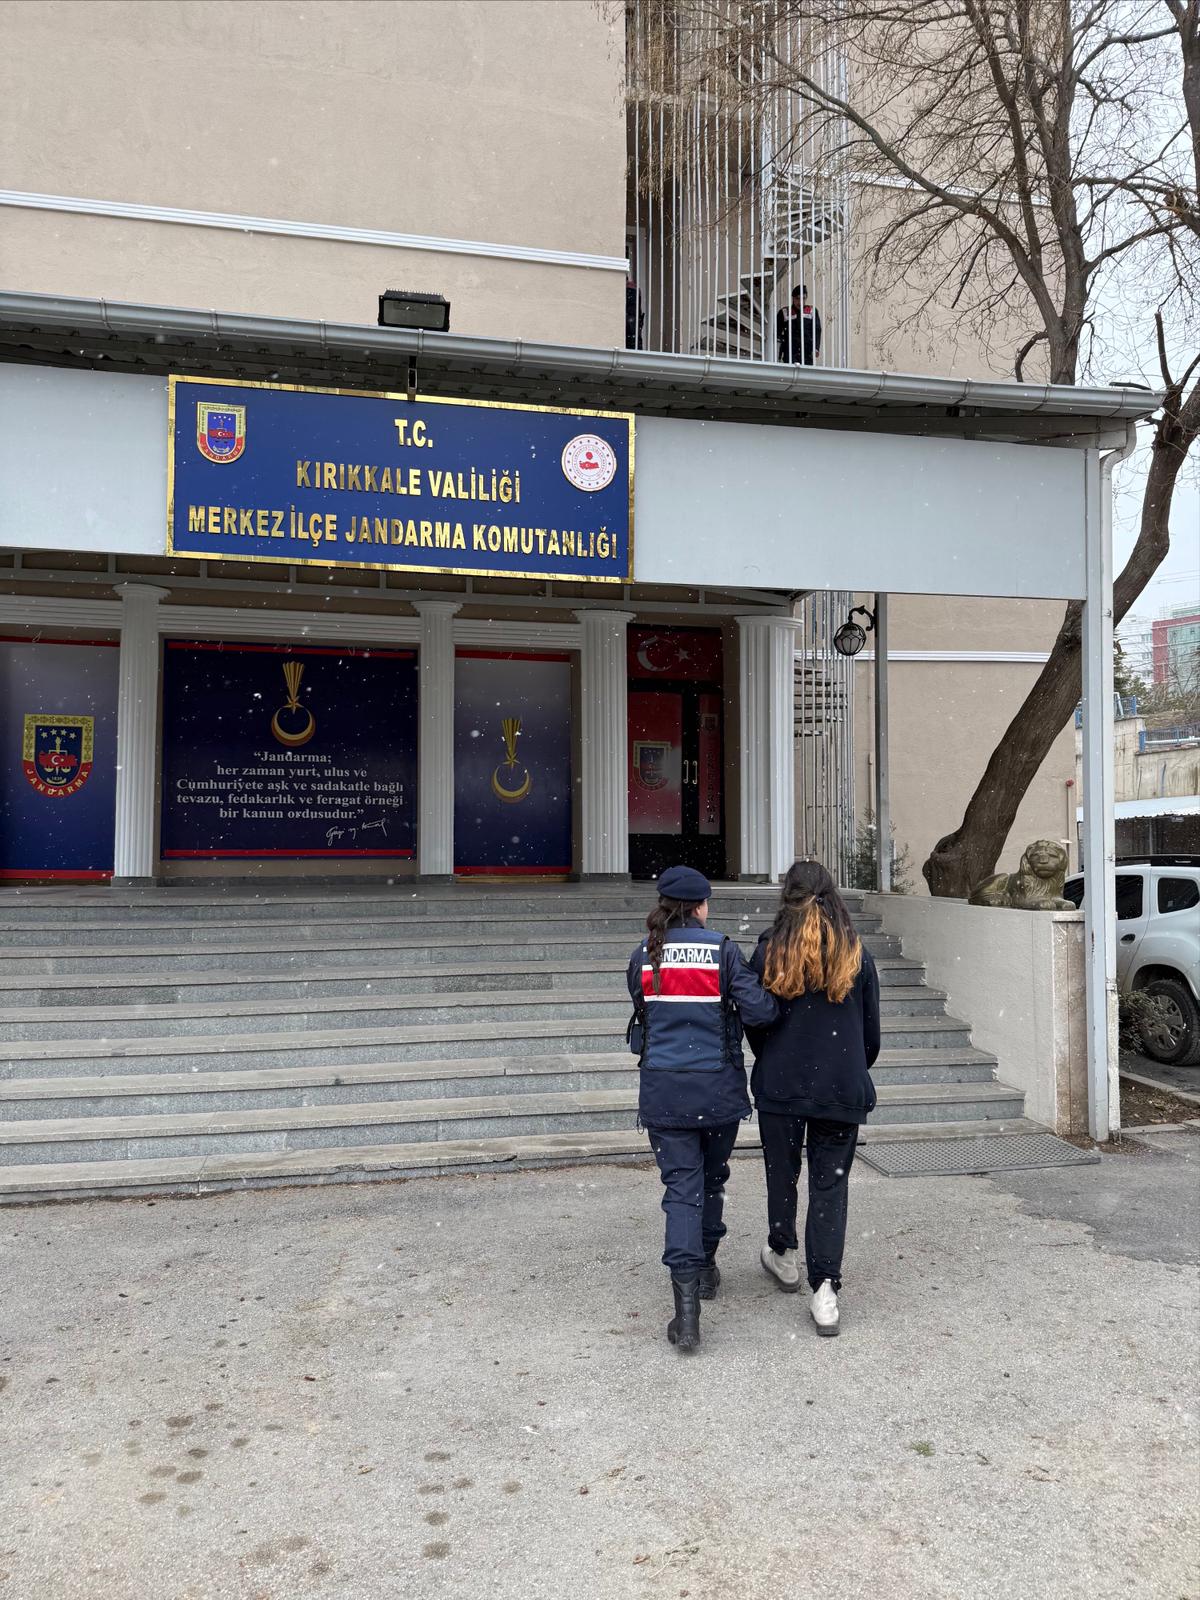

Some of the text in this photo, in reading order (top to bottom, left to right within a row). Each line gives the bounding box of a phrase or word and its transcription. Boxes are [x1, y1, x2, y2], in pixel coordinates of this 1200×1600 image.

[394, 419, 433, 447] T.C.
[296, 460, 521, 503] KIRIKKALE VALİLİĞİ
[188, 505, 617, 559] MERKEZ İLÇE JANDARMA KOMUTANLIĞI
[217, 765, 367, 778] her zaman yurt, ulus ve
[26, 769, 89, 796] JANDARMA
[176, 778, 404, 794] Cumhuriyete aşk ve sadakatle bağlı
[176, 793, 404, 808] tevazu, fedakarlık ve feragat örneği
[219, 808, 240, 818] bir
[242, 808, 284, 819] kanun
[663, 948, 713, 964] NDARMA
